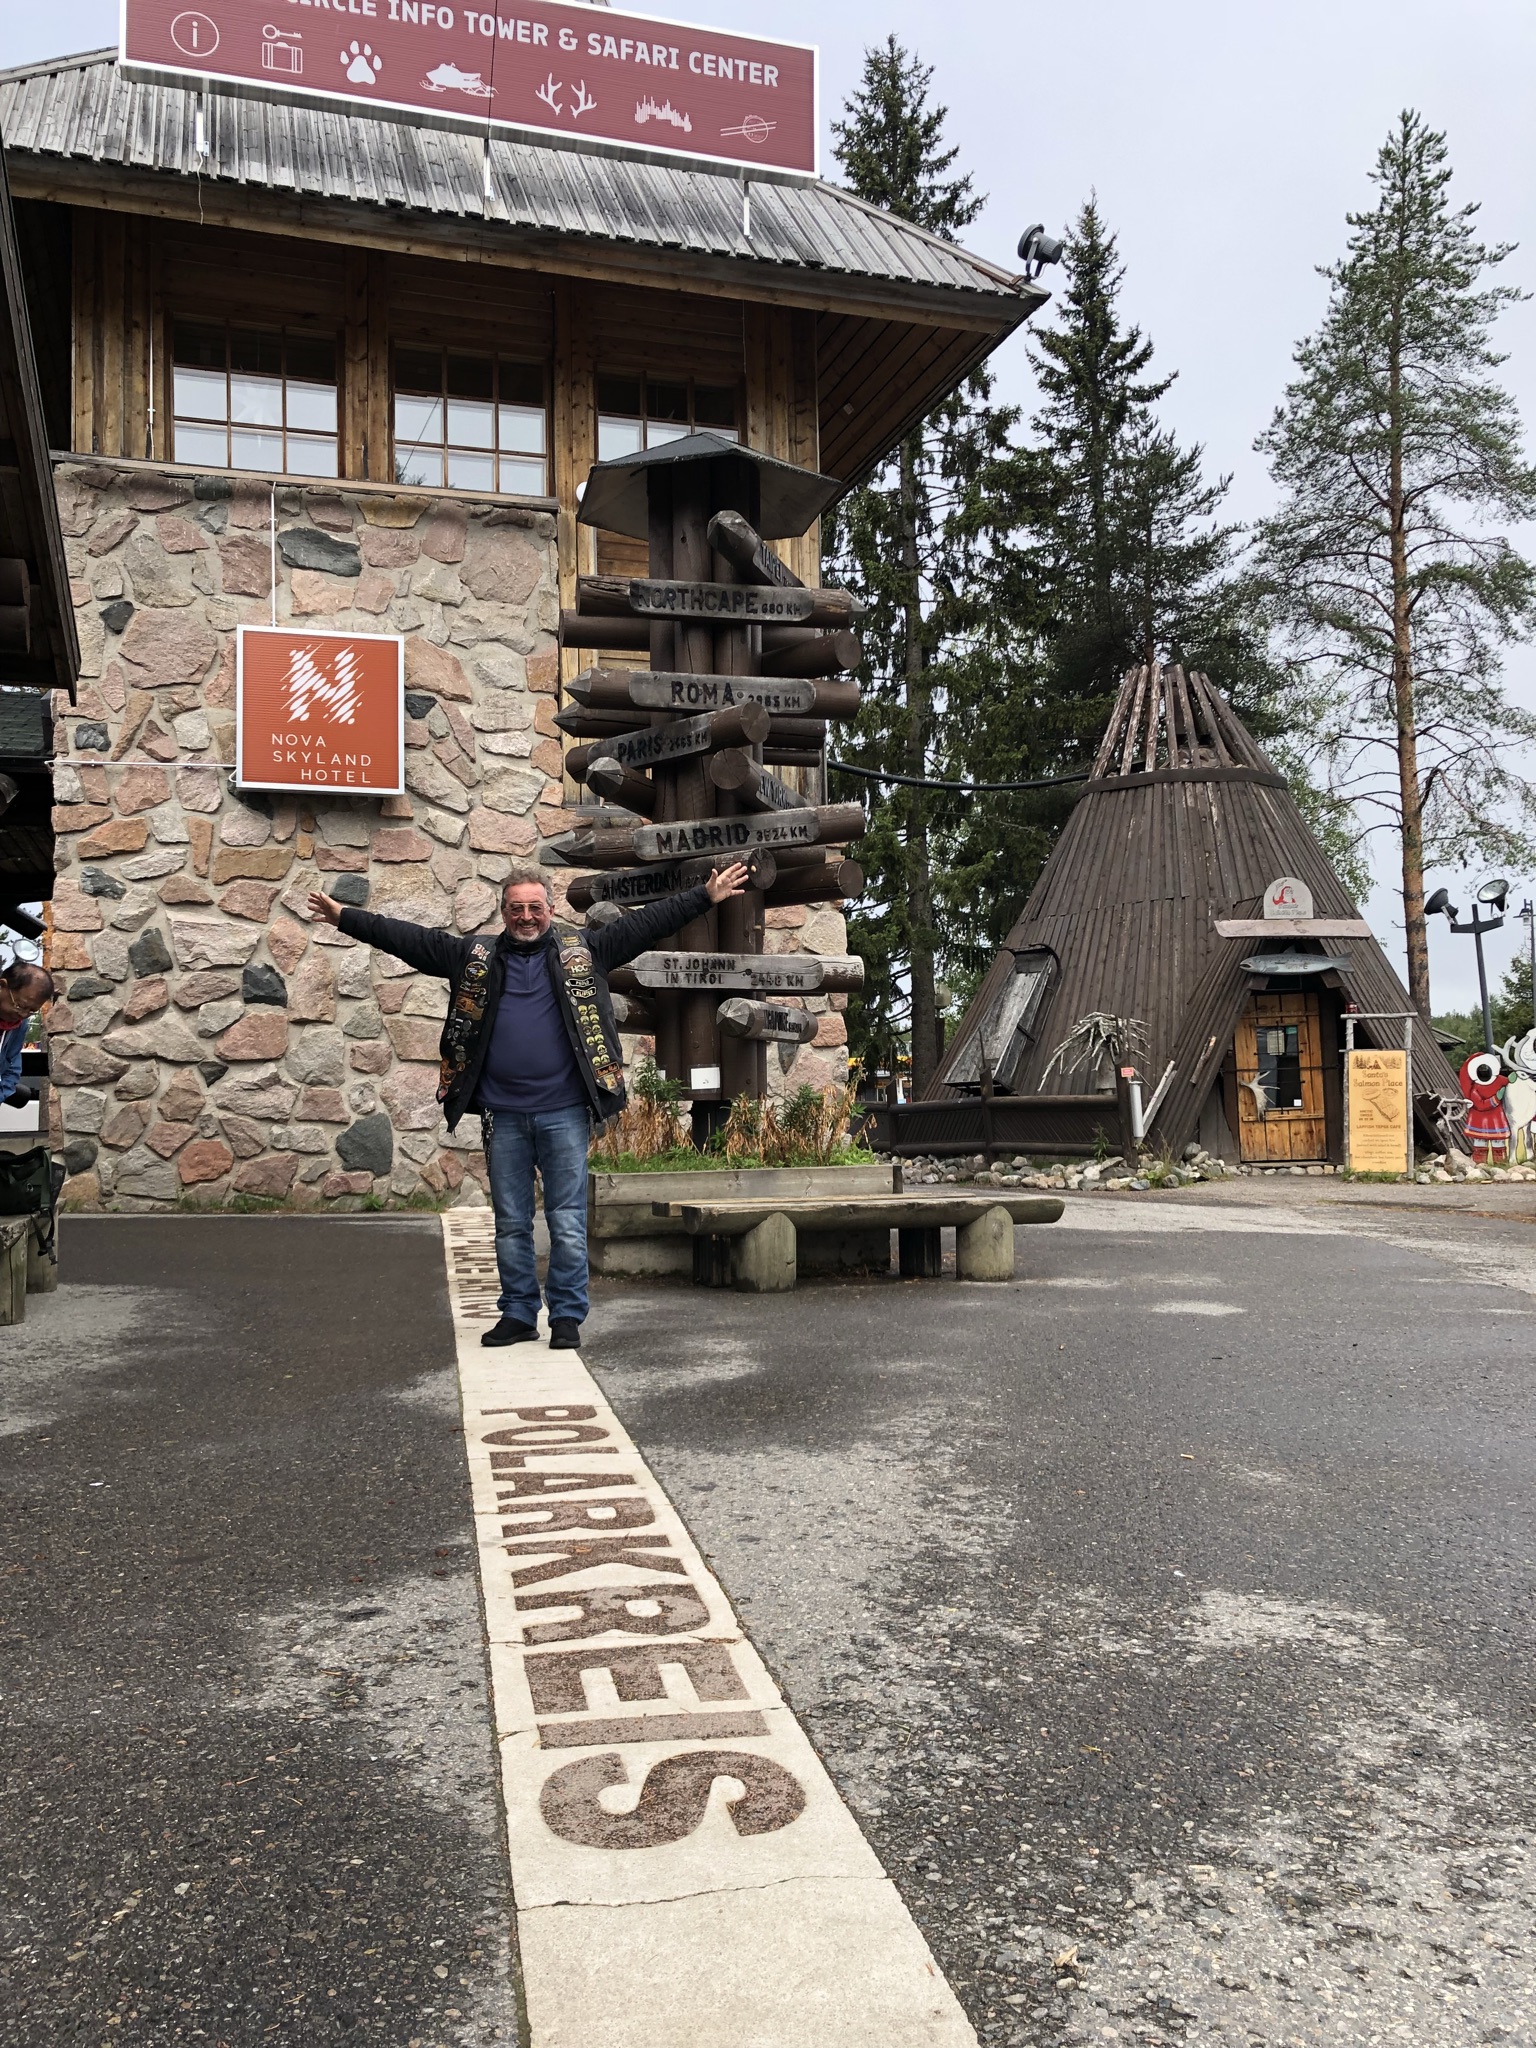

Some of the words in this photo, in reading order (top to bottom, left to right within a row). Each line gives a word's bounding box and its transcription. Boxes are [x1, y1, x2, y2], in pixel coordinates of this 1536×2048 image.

[388, 1, 454, 29] INFO
[463, 10, 549, 46] TOWER
[558, 28, 578, 51] &
[587, 32, 680, 70] SAFARI
[688, 51, 779, 87] CENTER
[761, 602, 784, 615] 680
[671, 680, 736, 706] ROMA
[784, 695, 800, 708] KM
[271, 733, 327, 748] NOVA
[617, 734, 663, 764] PARIS
[272, 750, 372, 767] SKYLAND
[300, 769, 371, 784] HOTEL
[656, 822, 750, 854] MADRID
[790, 825, 808, 838] KM
[602, 869, 681, 900] AMSTERDAM
[665, 973, 679, 984] IN
[684, 973, 724, 985] TIROL
[786, 975, 804, 987] KM
[1353, 1079, 1380, 1088] Salmon
[1382, 1078, 1403, 1087] Place
[481, 1404, 807, 1850] POLARKREIS
